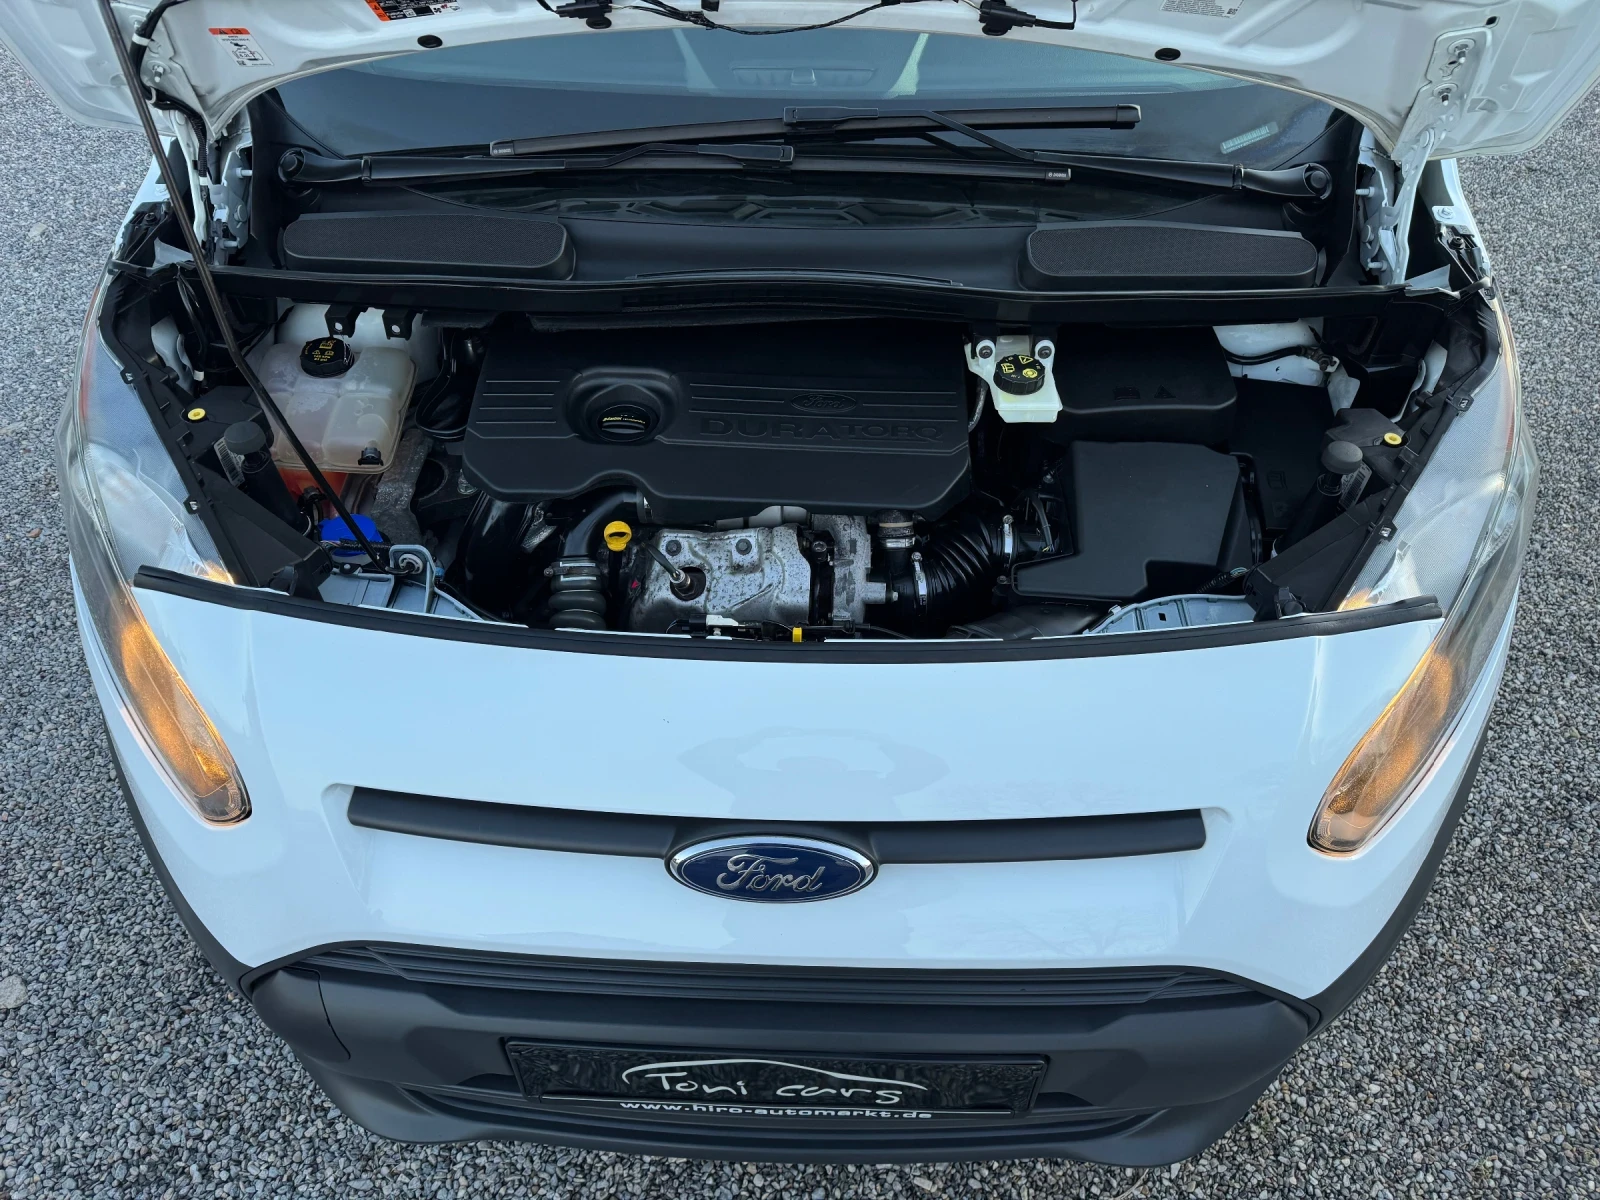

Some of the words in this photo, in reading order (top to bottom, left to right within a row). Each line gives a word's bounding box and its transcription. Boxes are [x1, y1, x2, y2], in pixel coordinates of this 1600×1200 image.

[803, 394, 845, 409] Ford
[700, 417, 943, 443] DURATORQ
[716, 853, 826, 892] Ford
[644, 1071, 747, 1098] Toni
[775, 1083, 903, 1105] cars
[620, 1101, 932, 1119] www.hiro-automarkt.de
